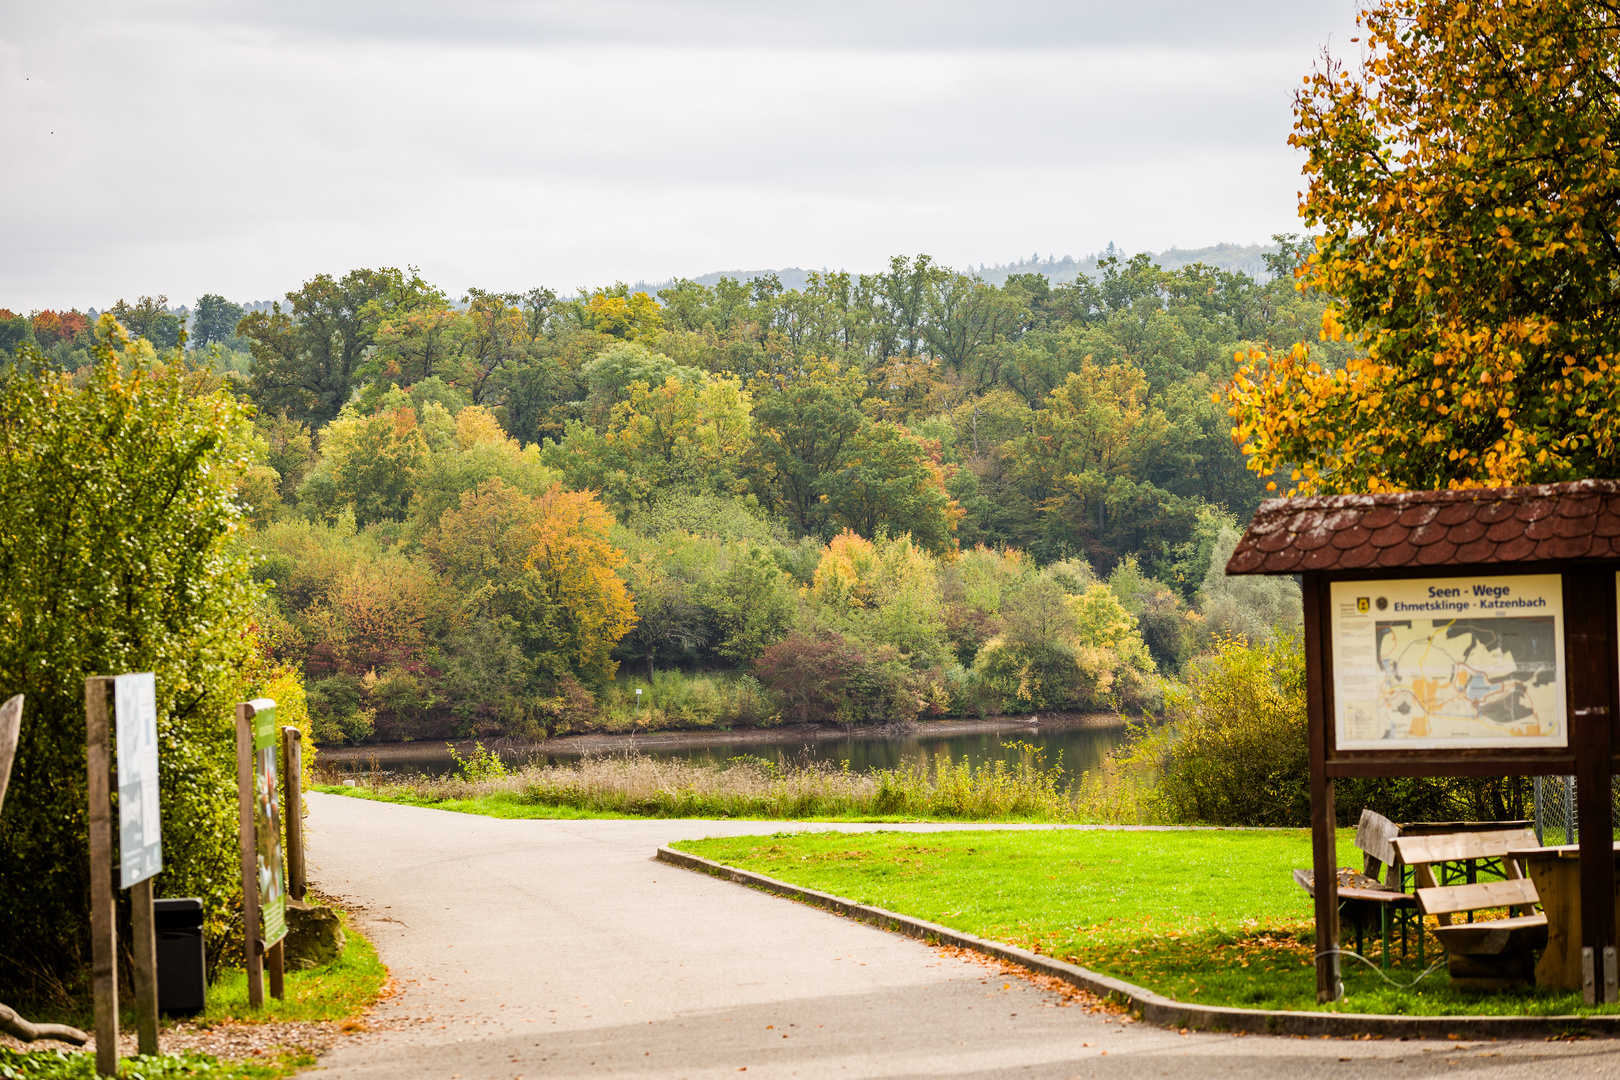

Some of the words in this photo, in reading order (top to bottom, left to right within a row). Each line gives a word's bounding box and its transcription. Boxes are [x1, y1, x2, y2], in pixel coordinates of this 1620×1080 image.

[1428, 586, 1460, 598] Seen
[1472, 584, 1510, 598] Wege
[1394, 600, 1470, 612] Ehmetsklinge
[1480, 597, 1546, 609] Katzenbach
